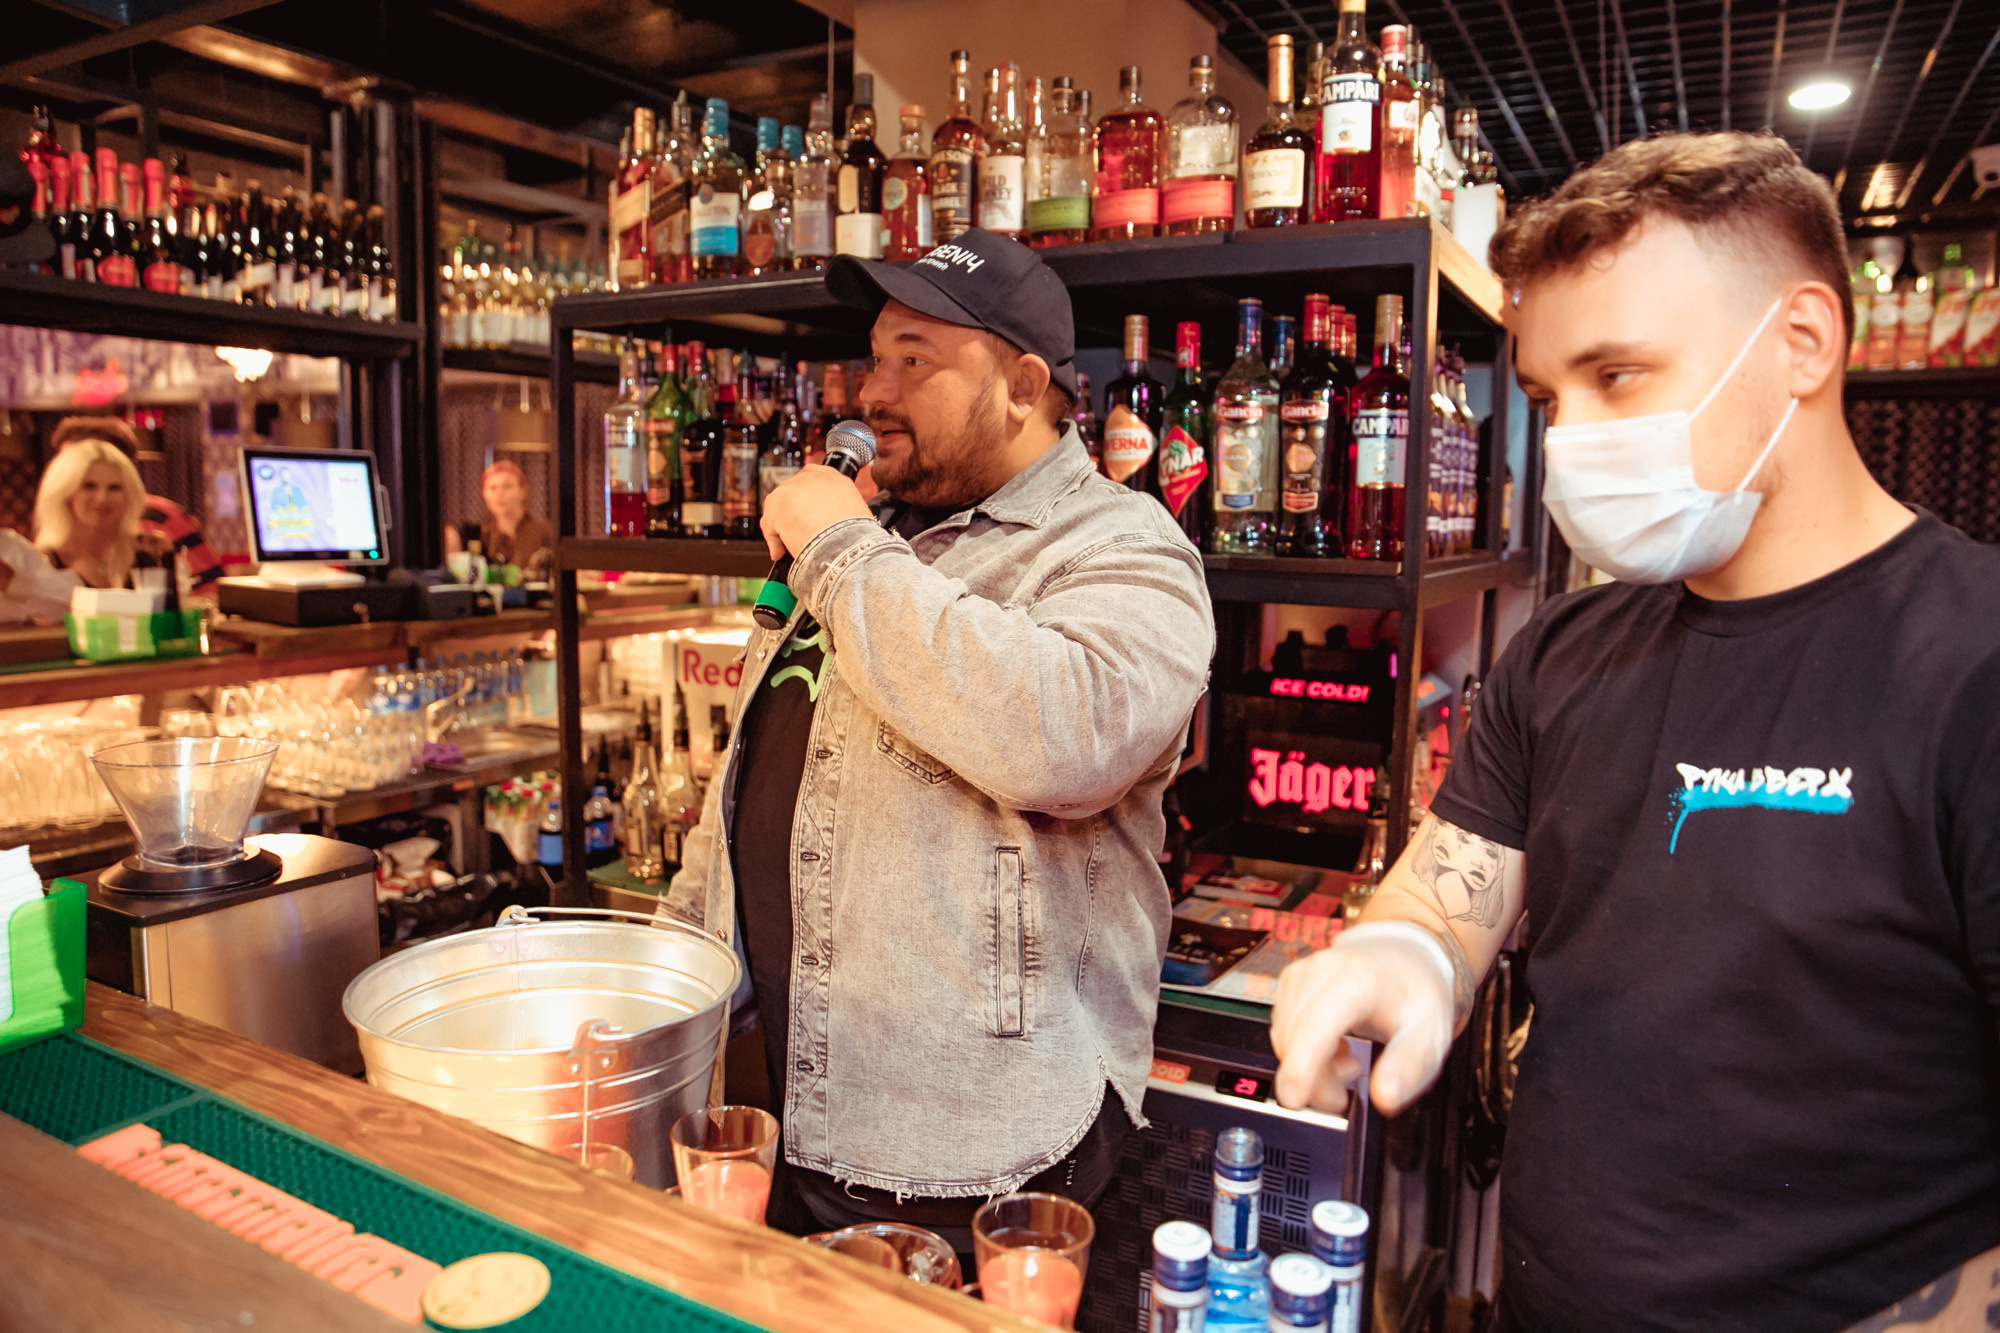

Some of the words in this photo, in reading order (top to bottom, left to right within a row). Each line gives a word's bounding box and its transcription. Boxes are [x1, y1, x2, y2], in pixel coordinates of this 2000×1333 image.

[1320, 81, 1380, 104] AMPARI
[1270, 678, 1306, 696] ICE
[1306, 681, 1370, 702] COLD!
[1249, 748, 1376, 813] Jäger
